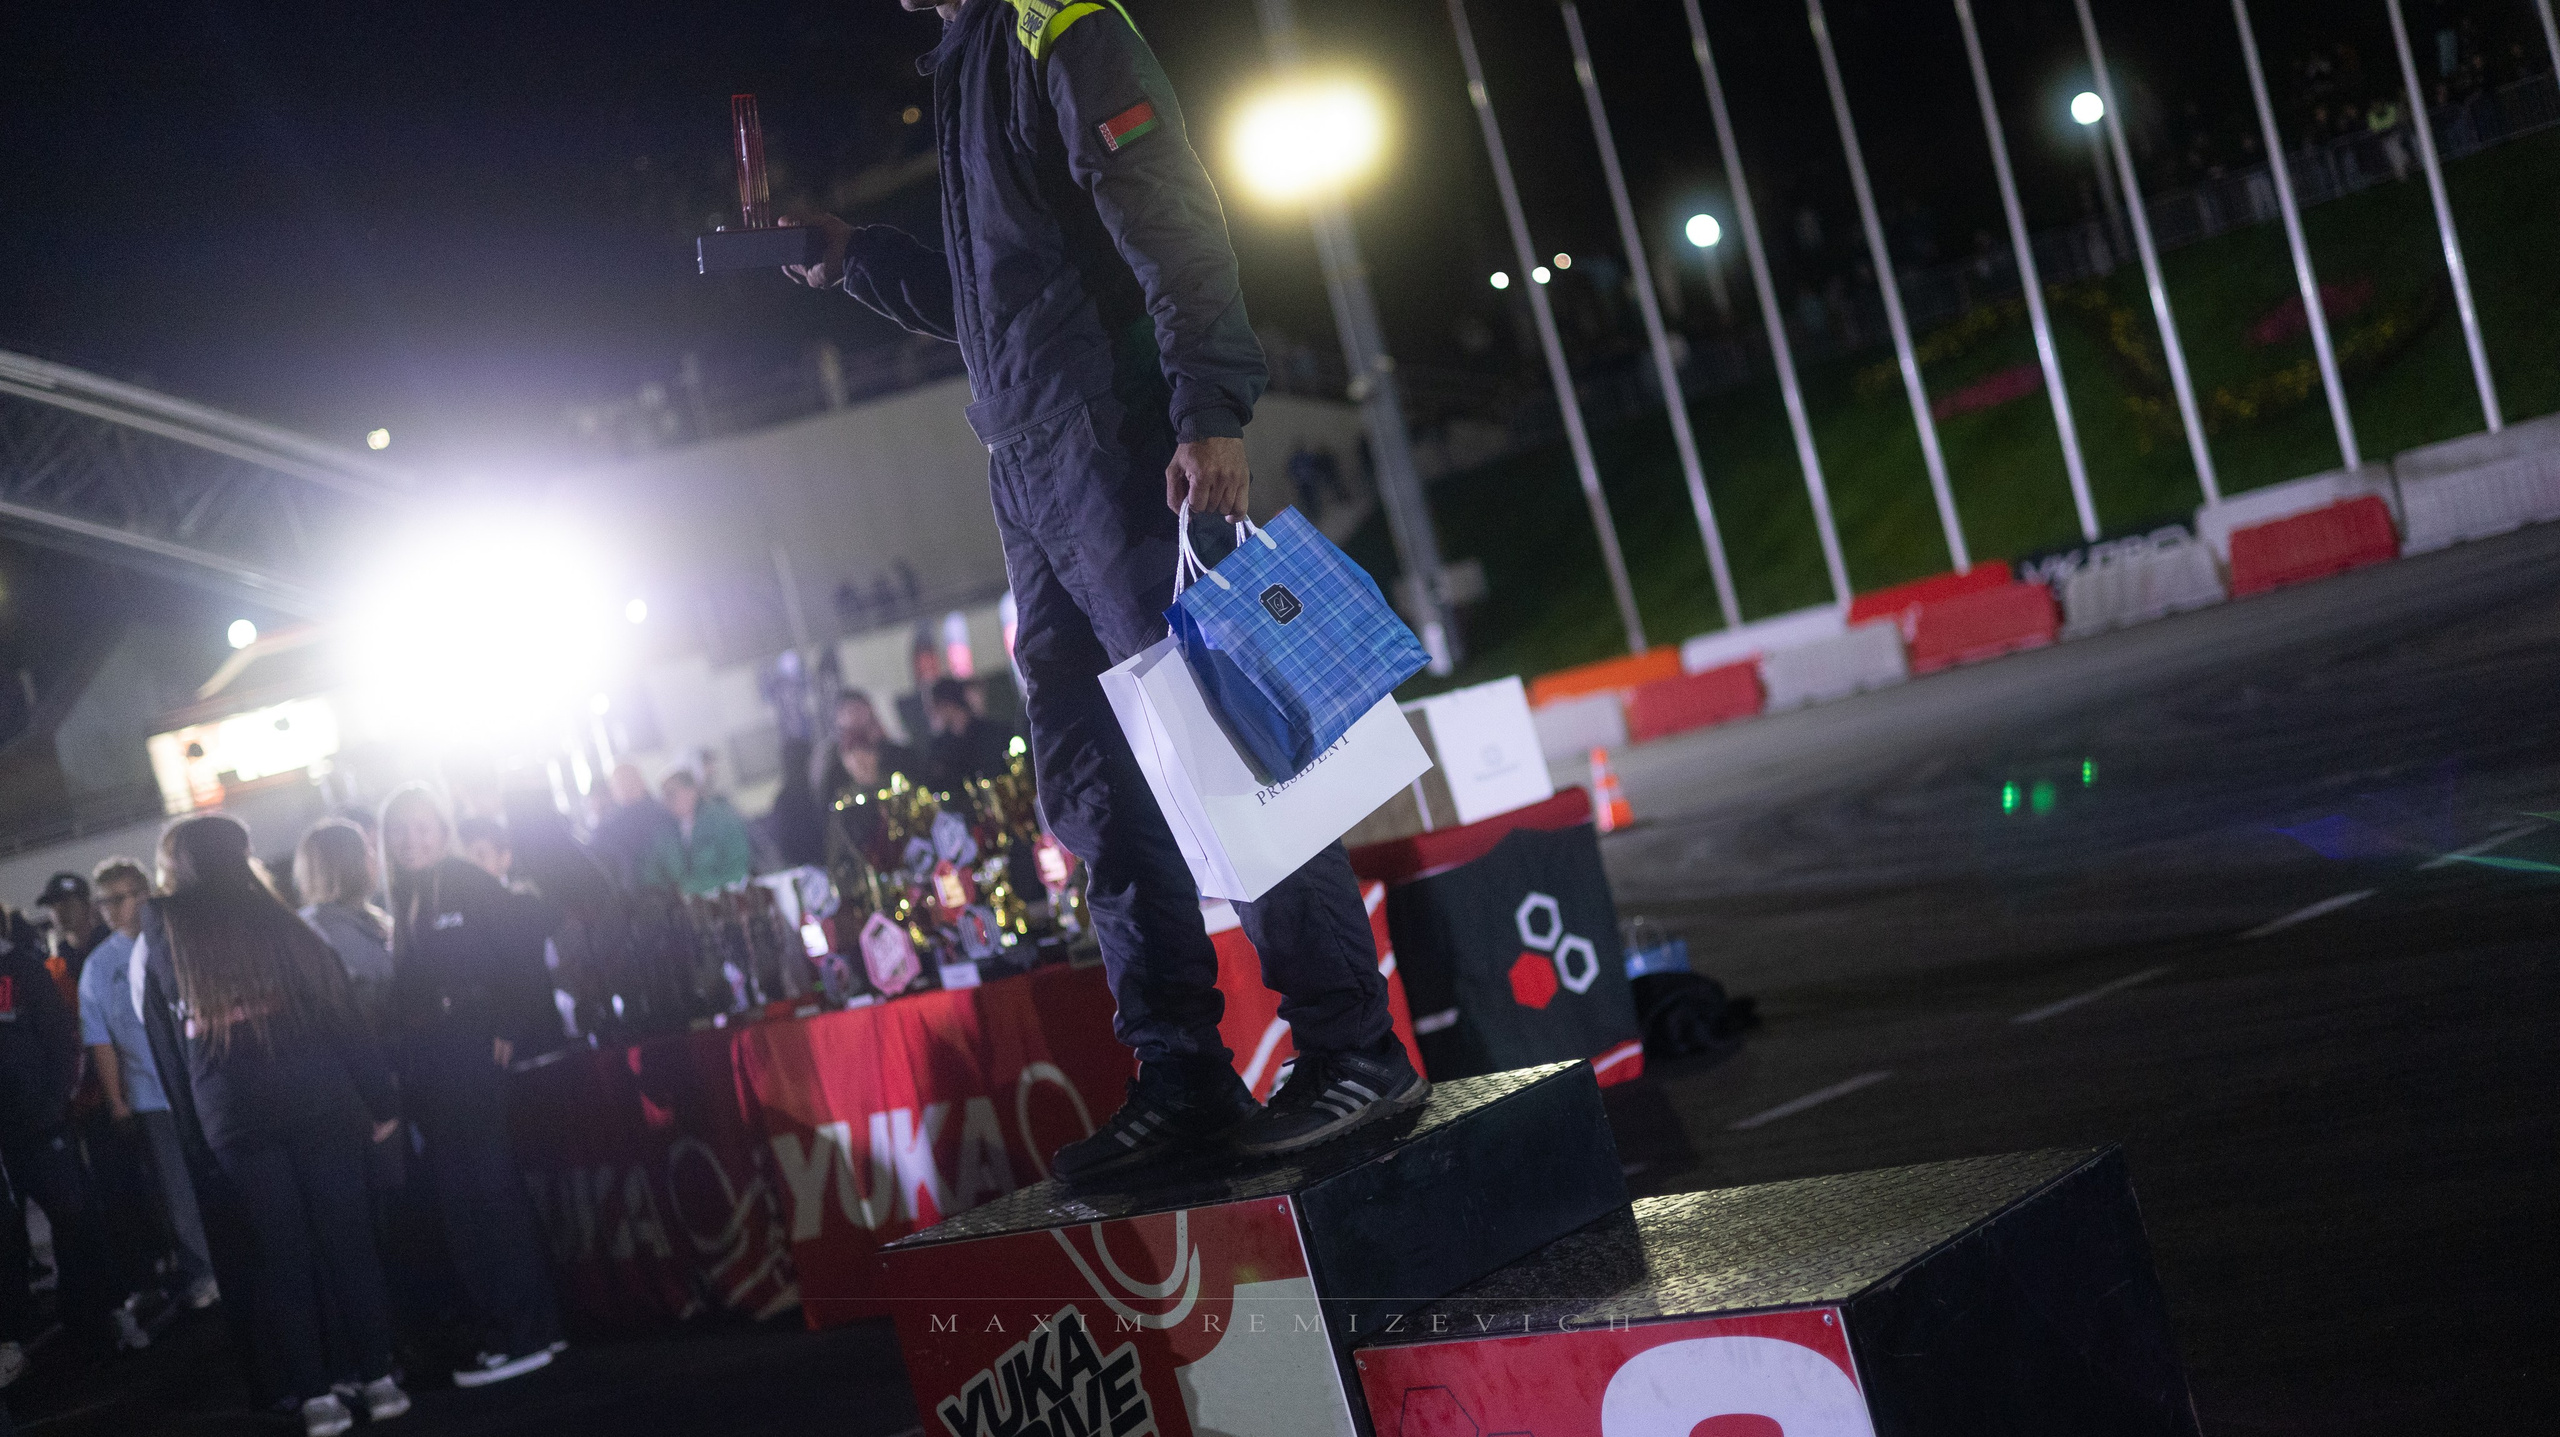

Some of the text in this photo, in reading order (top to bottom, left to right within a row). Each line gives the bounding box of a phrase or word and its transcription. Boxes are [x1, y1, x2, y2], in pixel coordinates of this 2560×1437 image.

[525, 1162, 674, 1262] UKA
[771, 1095, 1019, 1243] YUKA
[943, 1312, 1104, 1437] YUKA
